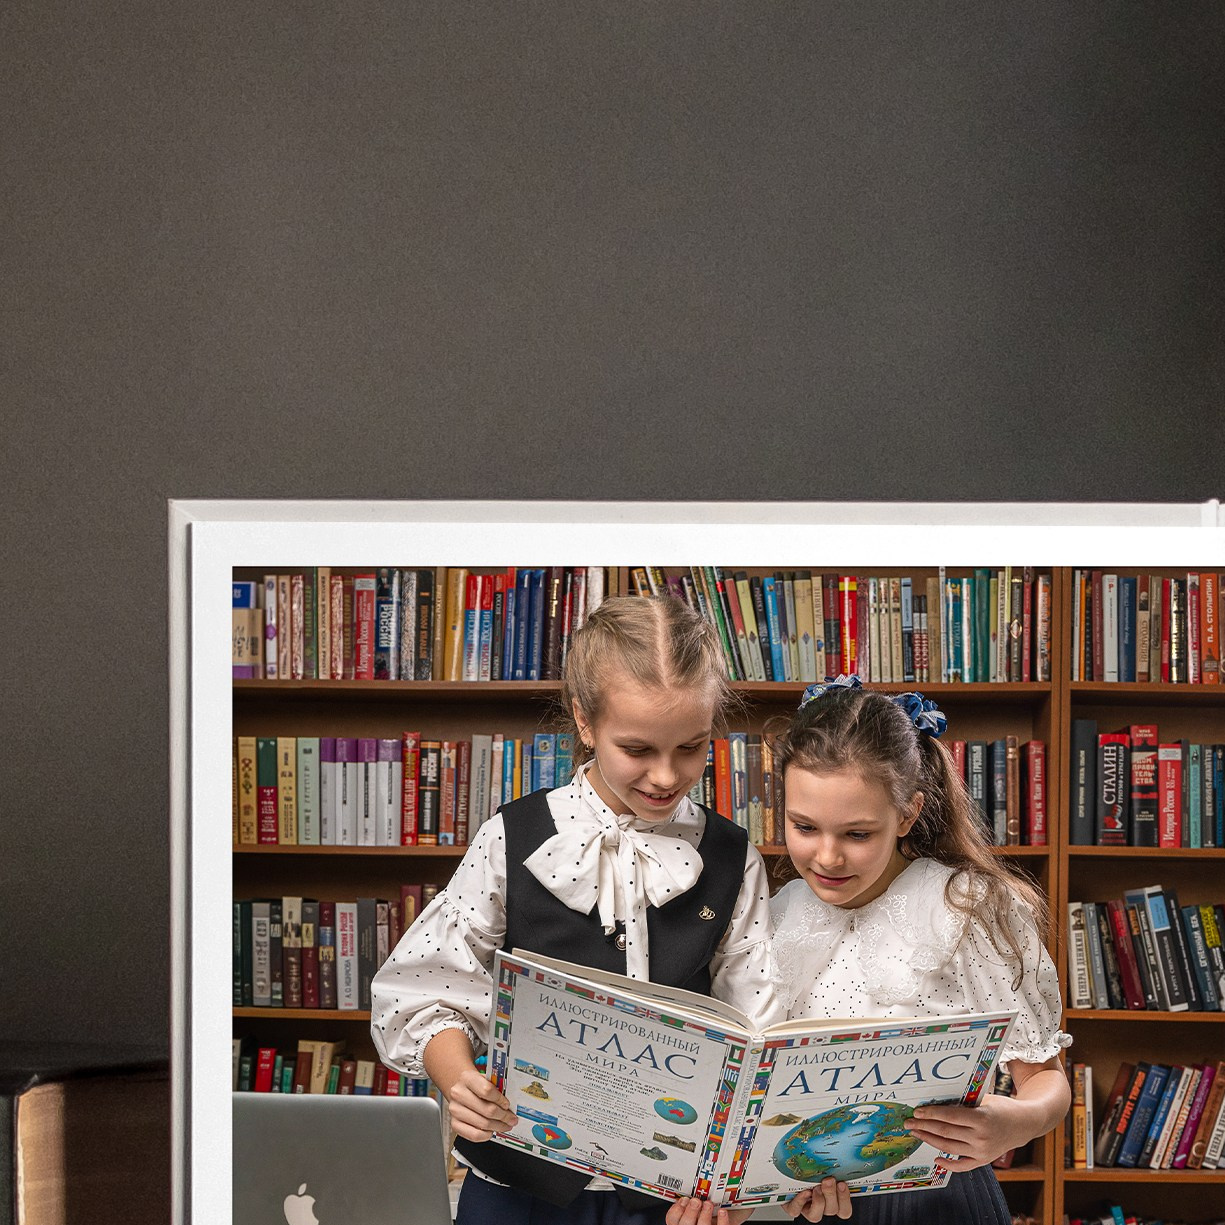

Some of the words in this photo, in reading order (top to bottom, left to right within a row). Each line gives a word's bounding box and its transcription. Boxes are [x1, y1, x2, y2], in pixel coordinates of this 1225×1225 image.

[814, 586, 823, 626] СЛАВЯНЕ
[1205, 578, 1214, 624] СТОЛЫПИН
[1206, 624, 1214, 634] А.
[1206, 632, 1214, 643] П.
[427, 751, 437, 782] РОССИИ
[1103, 745, 1117, 804] СТАЛИН
[1162, 790, 1175, 813] России
[1162, 812, 1177, 840] История
[538, 993, 701, 1056] ИЛЛЮСТРИРОВАННЫЙ
[536, 1011, 697, 1080] АТЛАС
[785, 1035, 977, 1067] ИЛЛЮСТРИРОВАННЫЙ
[586, 1053, 640, 1077] МИРА
[776, 1053, 971, 1097] АТЛАС
[834, 1091, 897, 1105] МИРА
